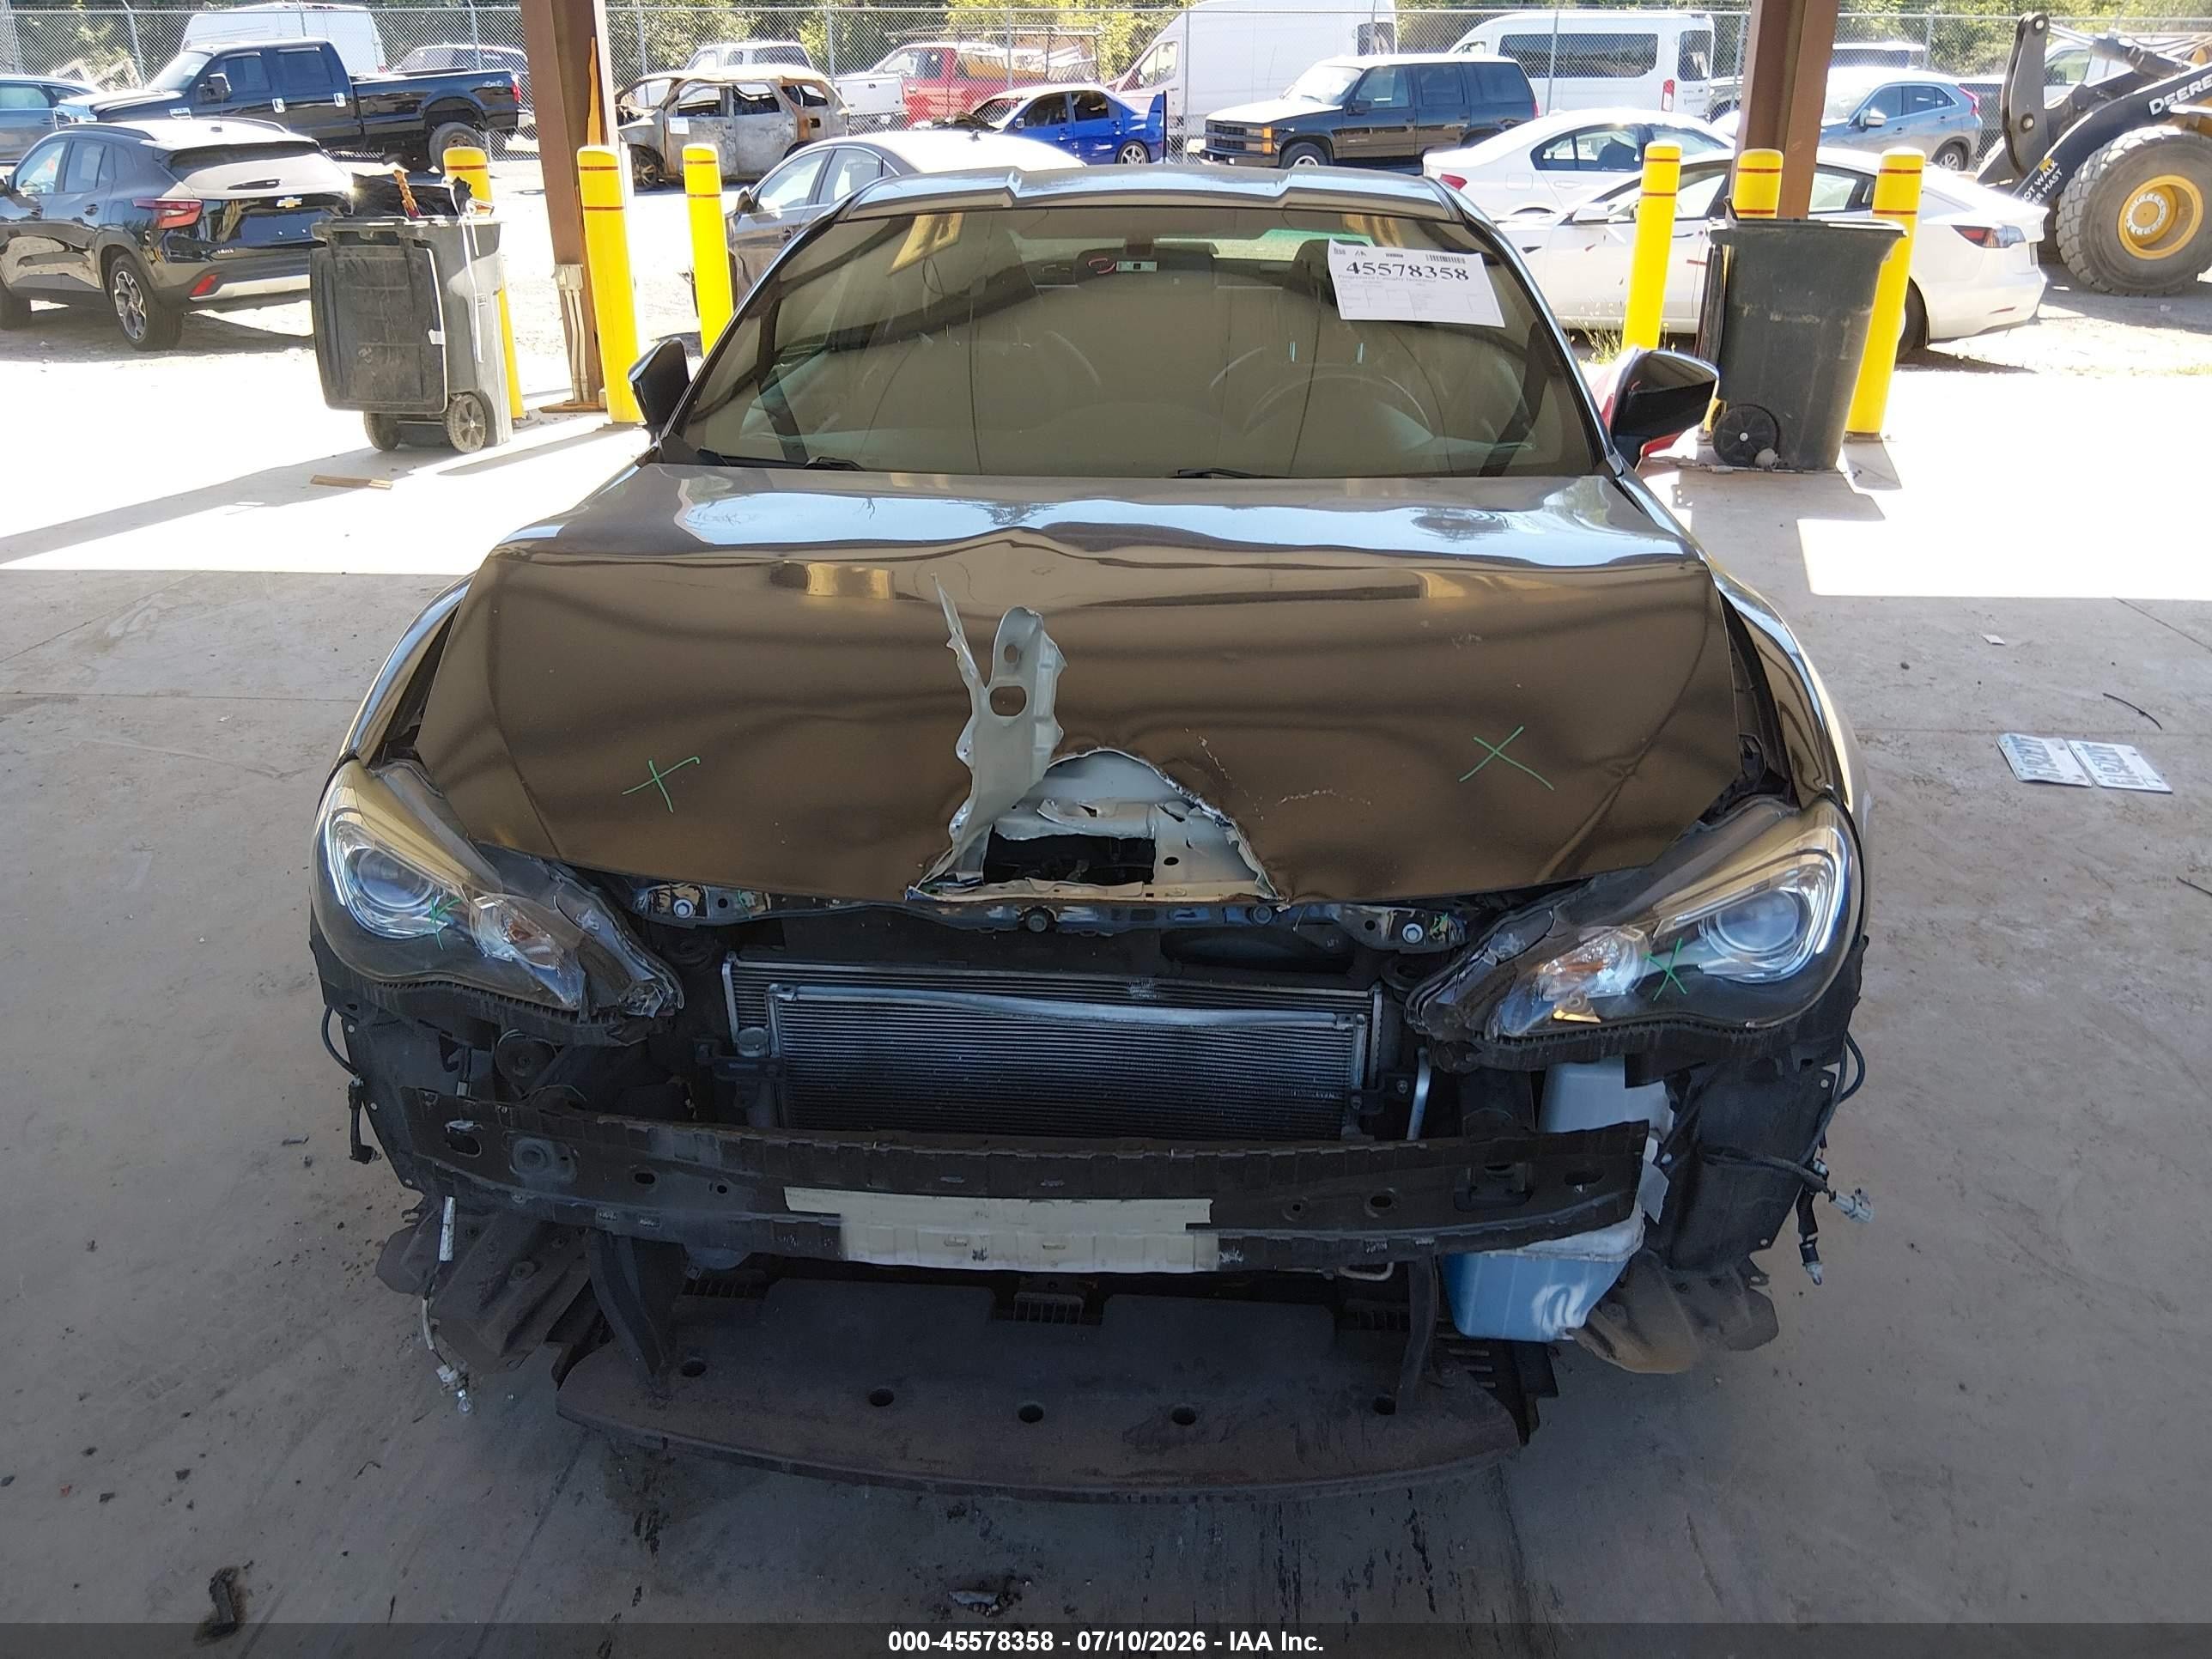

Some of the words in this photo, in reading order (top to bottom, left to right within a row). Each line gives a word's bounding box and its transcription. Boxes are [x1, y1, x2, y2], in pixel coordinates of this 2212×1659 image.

[2148, 74, 2212, 115] DEERE
[2021, 185, 2036, 202] OT
[2034, 160, 2059, 186] WALK
[2041, 167, 2063, 194] MAST
[1346, 261, 1469, 281] 45578358
